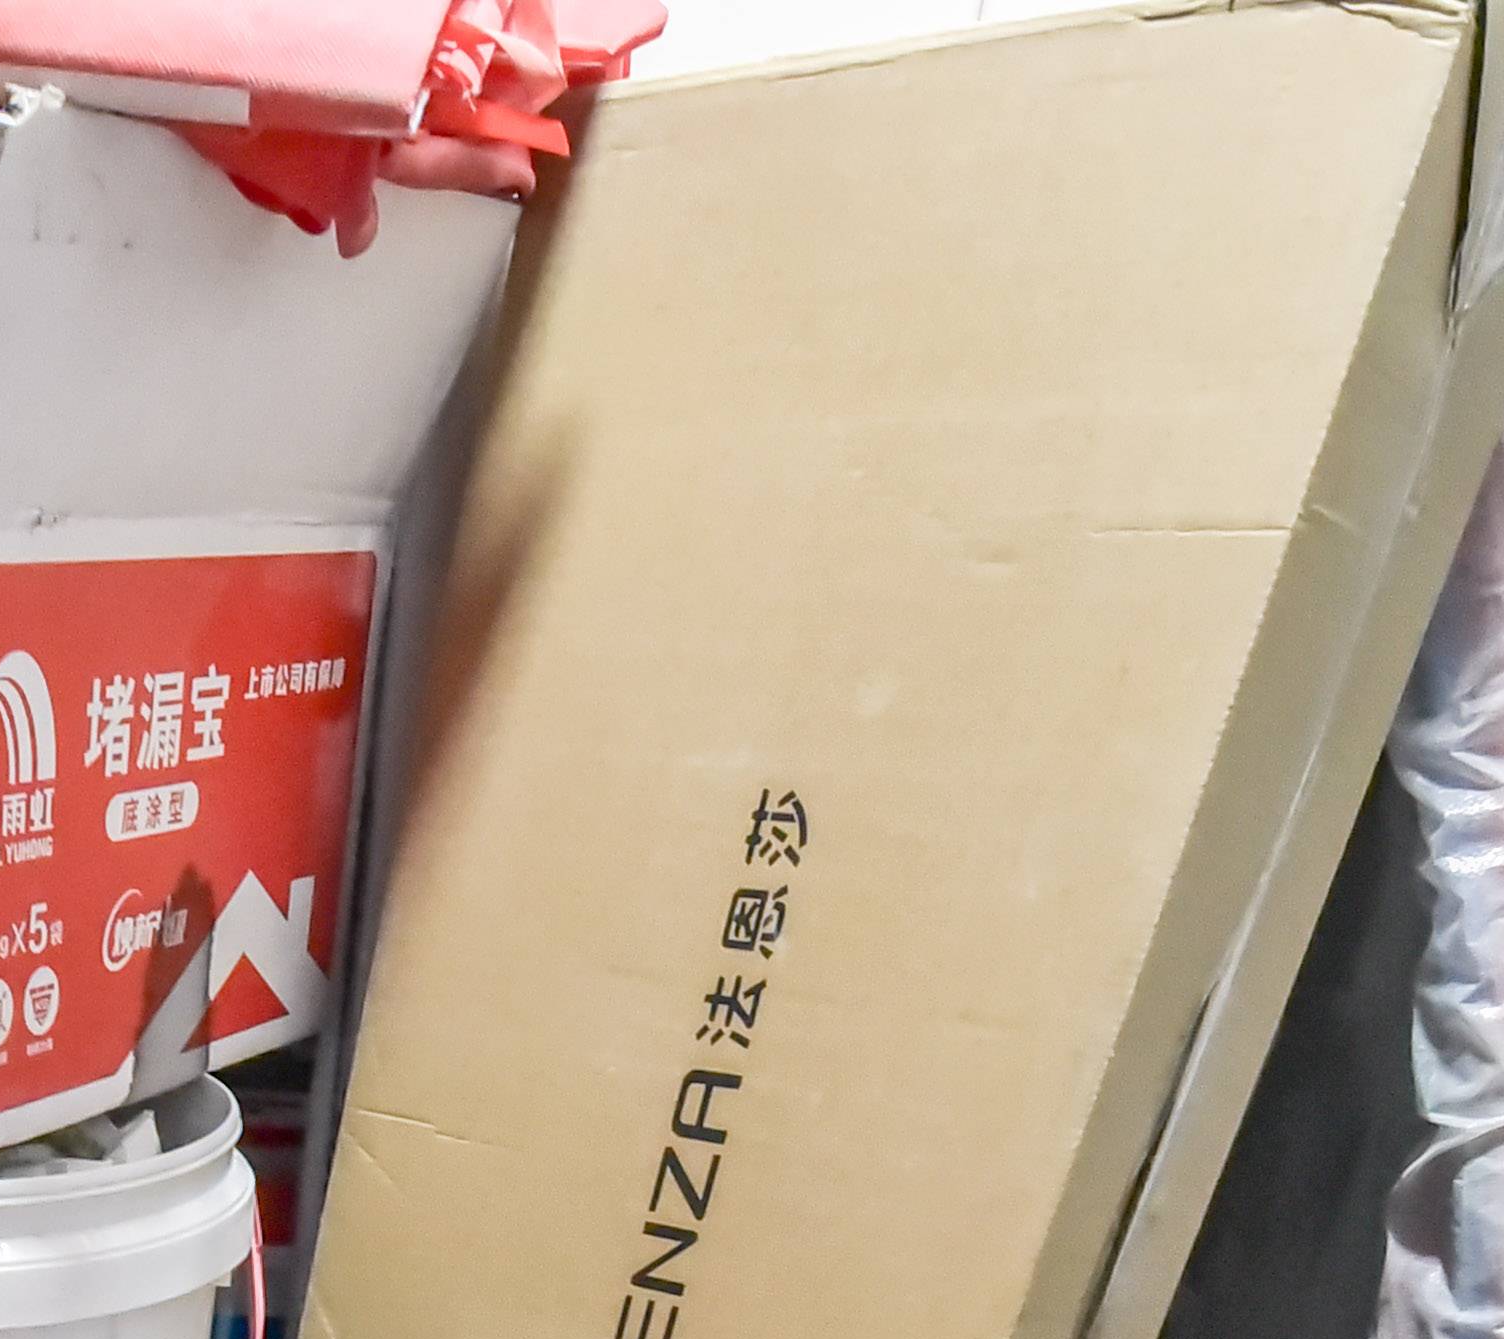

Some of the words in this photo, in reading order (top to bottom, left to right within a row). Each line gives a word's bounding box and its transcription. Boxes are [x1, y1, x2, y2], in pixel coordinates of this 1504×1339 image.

[84, 663, 232, 778] 堵漏宝
[244, 657, 348, 700] 上市公司有保障
[5, 836, 54, 864] YUHONG
[120, 789, 186, 835] 底涂型
[694, 787, 809, 1050] 法恩莎
